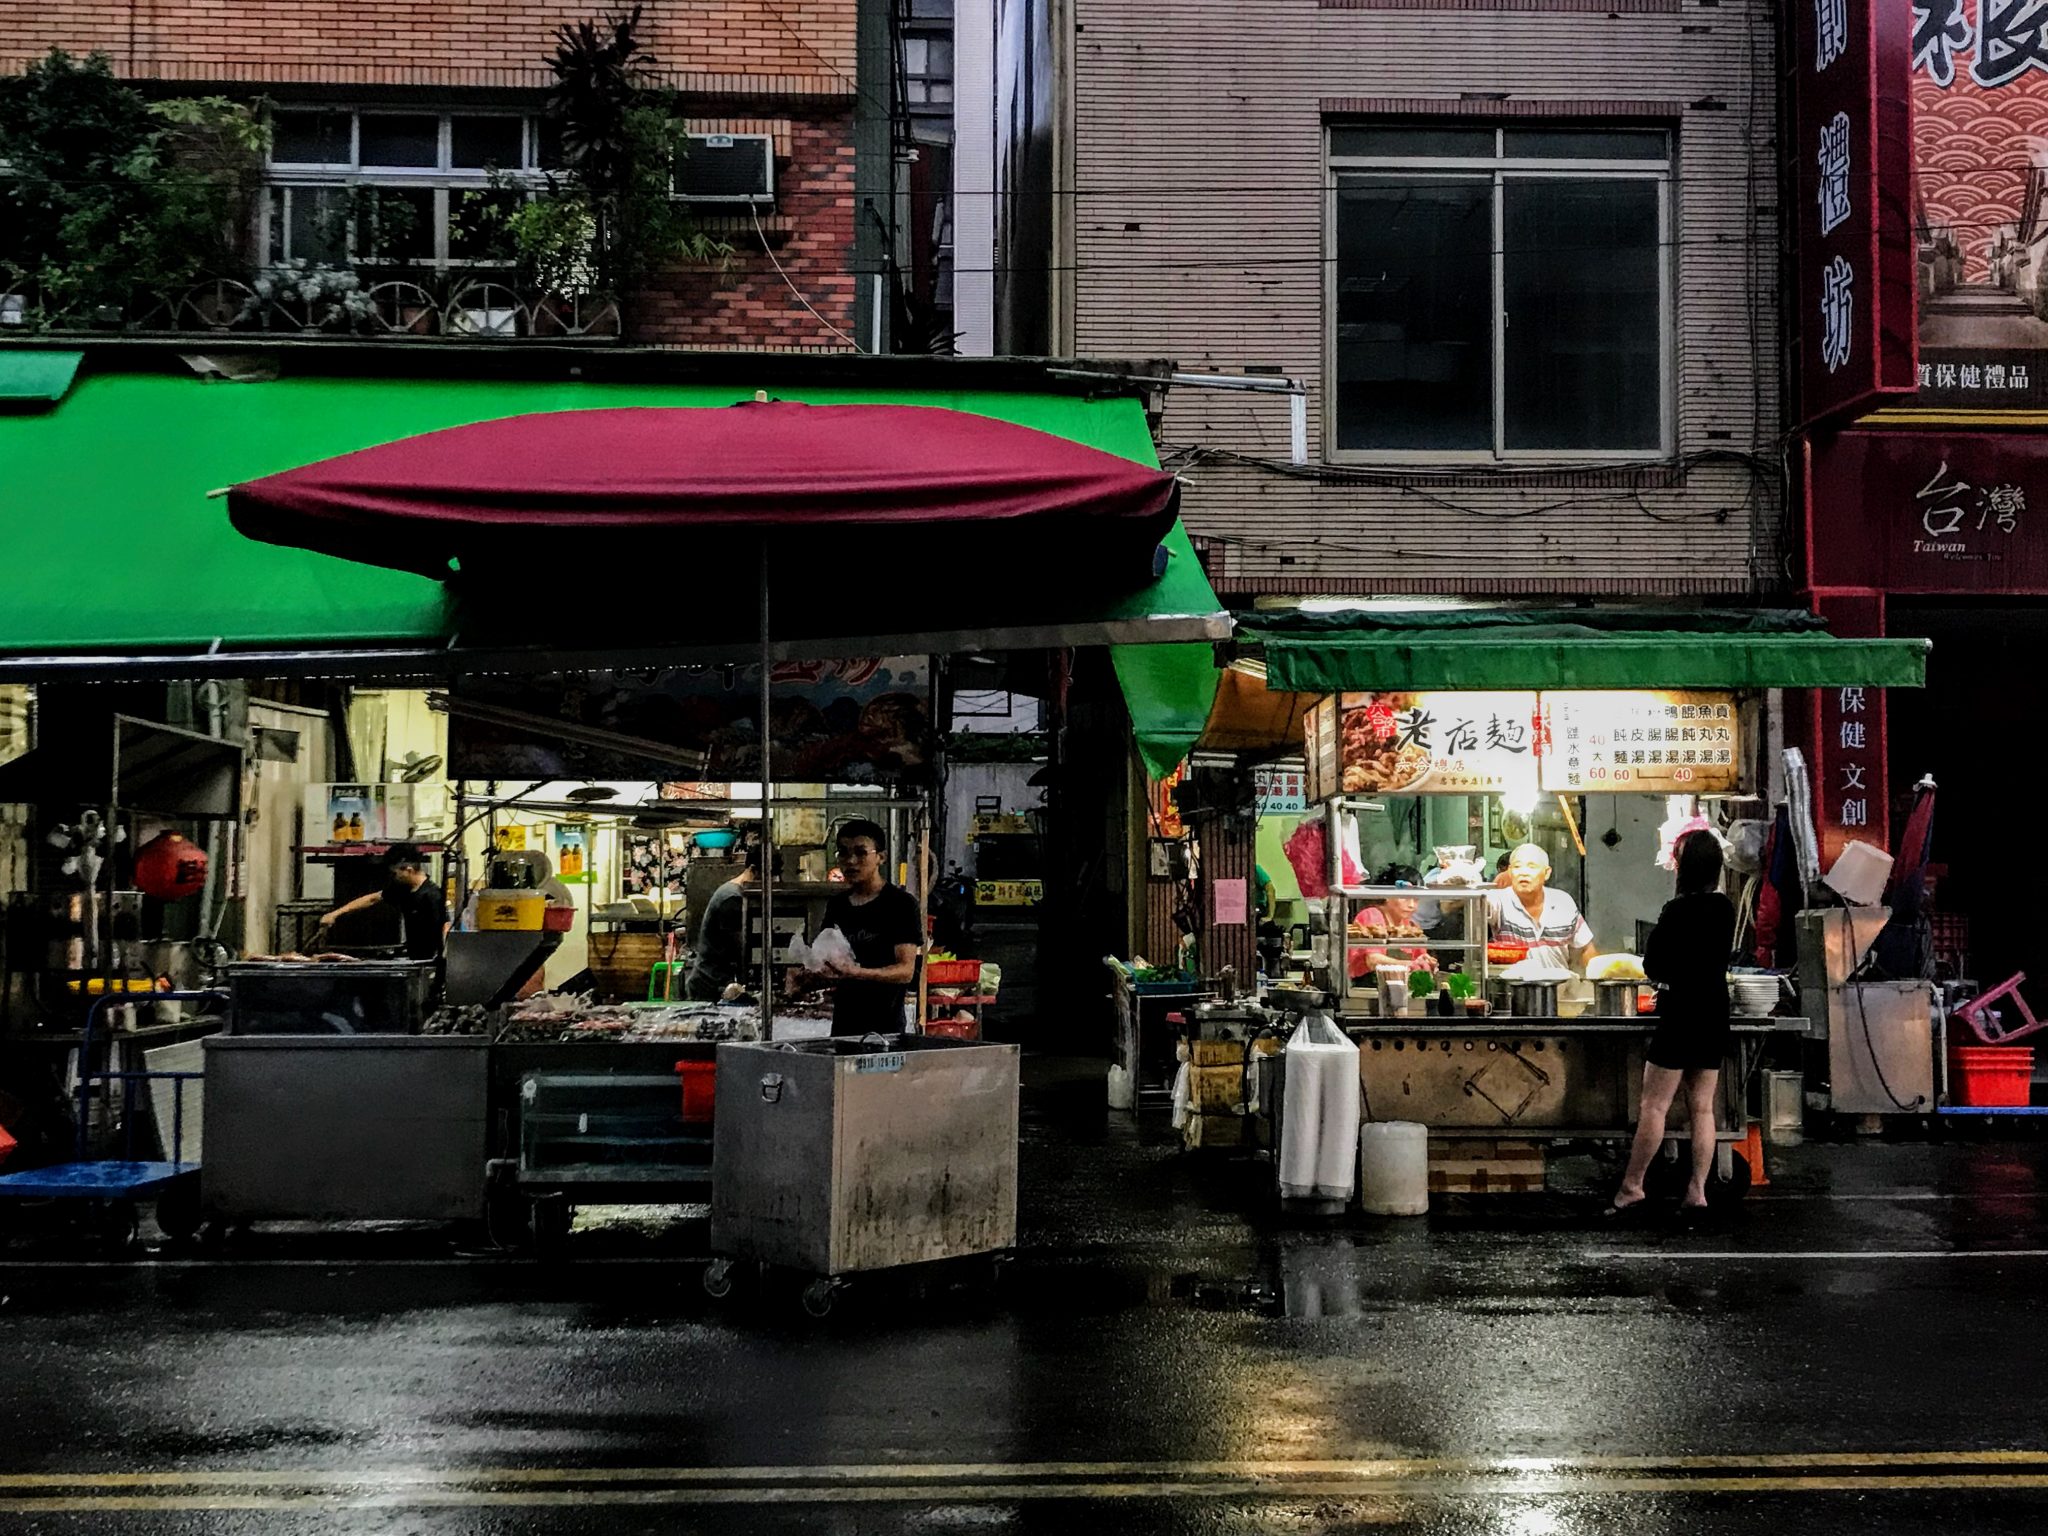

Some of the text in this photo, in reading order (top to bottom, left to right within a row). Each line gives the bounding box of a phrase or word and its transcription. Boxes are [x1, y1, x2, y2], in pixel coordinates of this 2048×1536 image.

[1915, 460, 2027, 537] 台灣
[1913, 540, 1966, 553] Taiwan
[1395, 708, 1528, 756] 老店麵
[1698, 705, 1713, 765] 魚丸湯
[1715, 705, 1730, 765] 貢丸湯
[1839, 687, 1867, 826] 保健文創
[1589, 767, 1606, 780] 60
[1614, 769, 1630, 781] 60
[1674, 769, 1692, 781] 40
[1270, 802, 1283, 810] 40
[1286, 802, 1298, 810] 40
